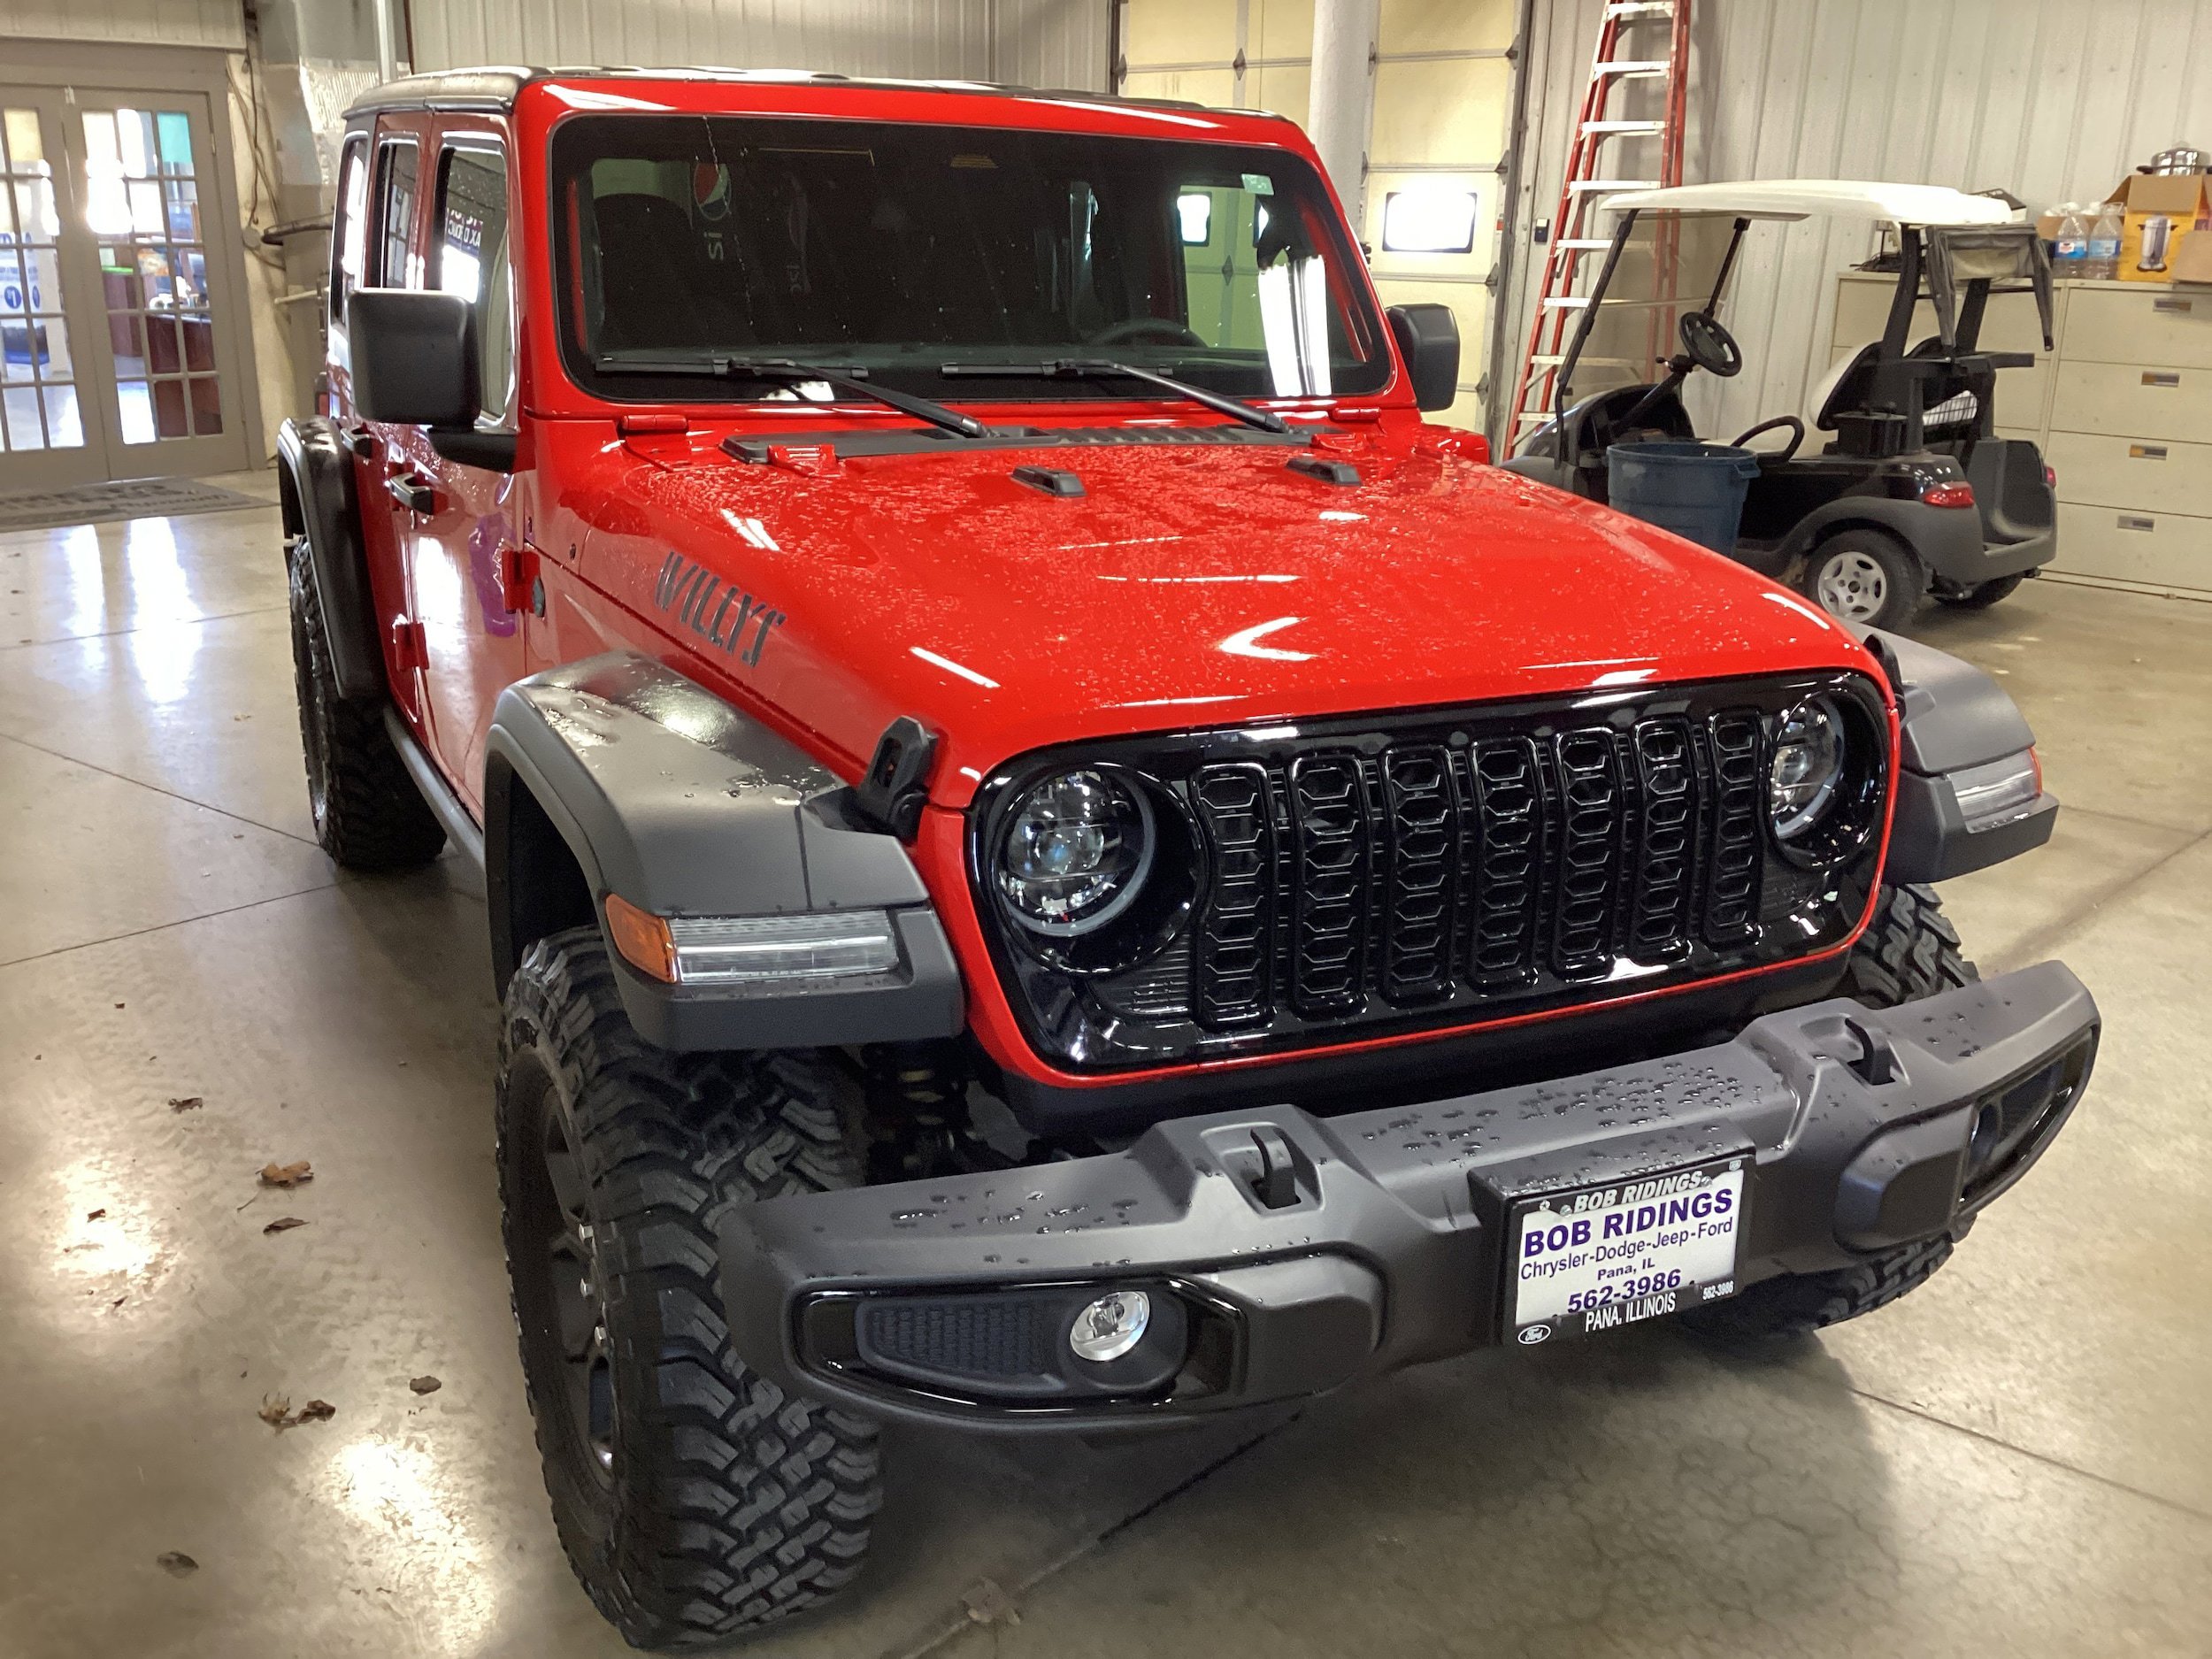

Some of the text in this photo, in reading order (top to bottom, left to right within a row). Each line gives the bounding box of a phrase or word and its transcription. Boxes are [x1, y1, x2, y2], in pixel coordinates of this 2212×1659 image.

[656, 551, 786, 666] WILLYS
[1574, 1171, 1703, 1213] BOB RIDINGS
[1524, 1188, 1732, 1257] BOB RIDINGS
[1521, 1217, 1732, 1279] Chrysler-Dodge-Jeep-Ford
[1597, 1257, 1655, 1281] Pana, IL
[1567, 1268, 1682, 1314] 562-3986
[1625, 1292, 1677, 1323] ILLINOIS
